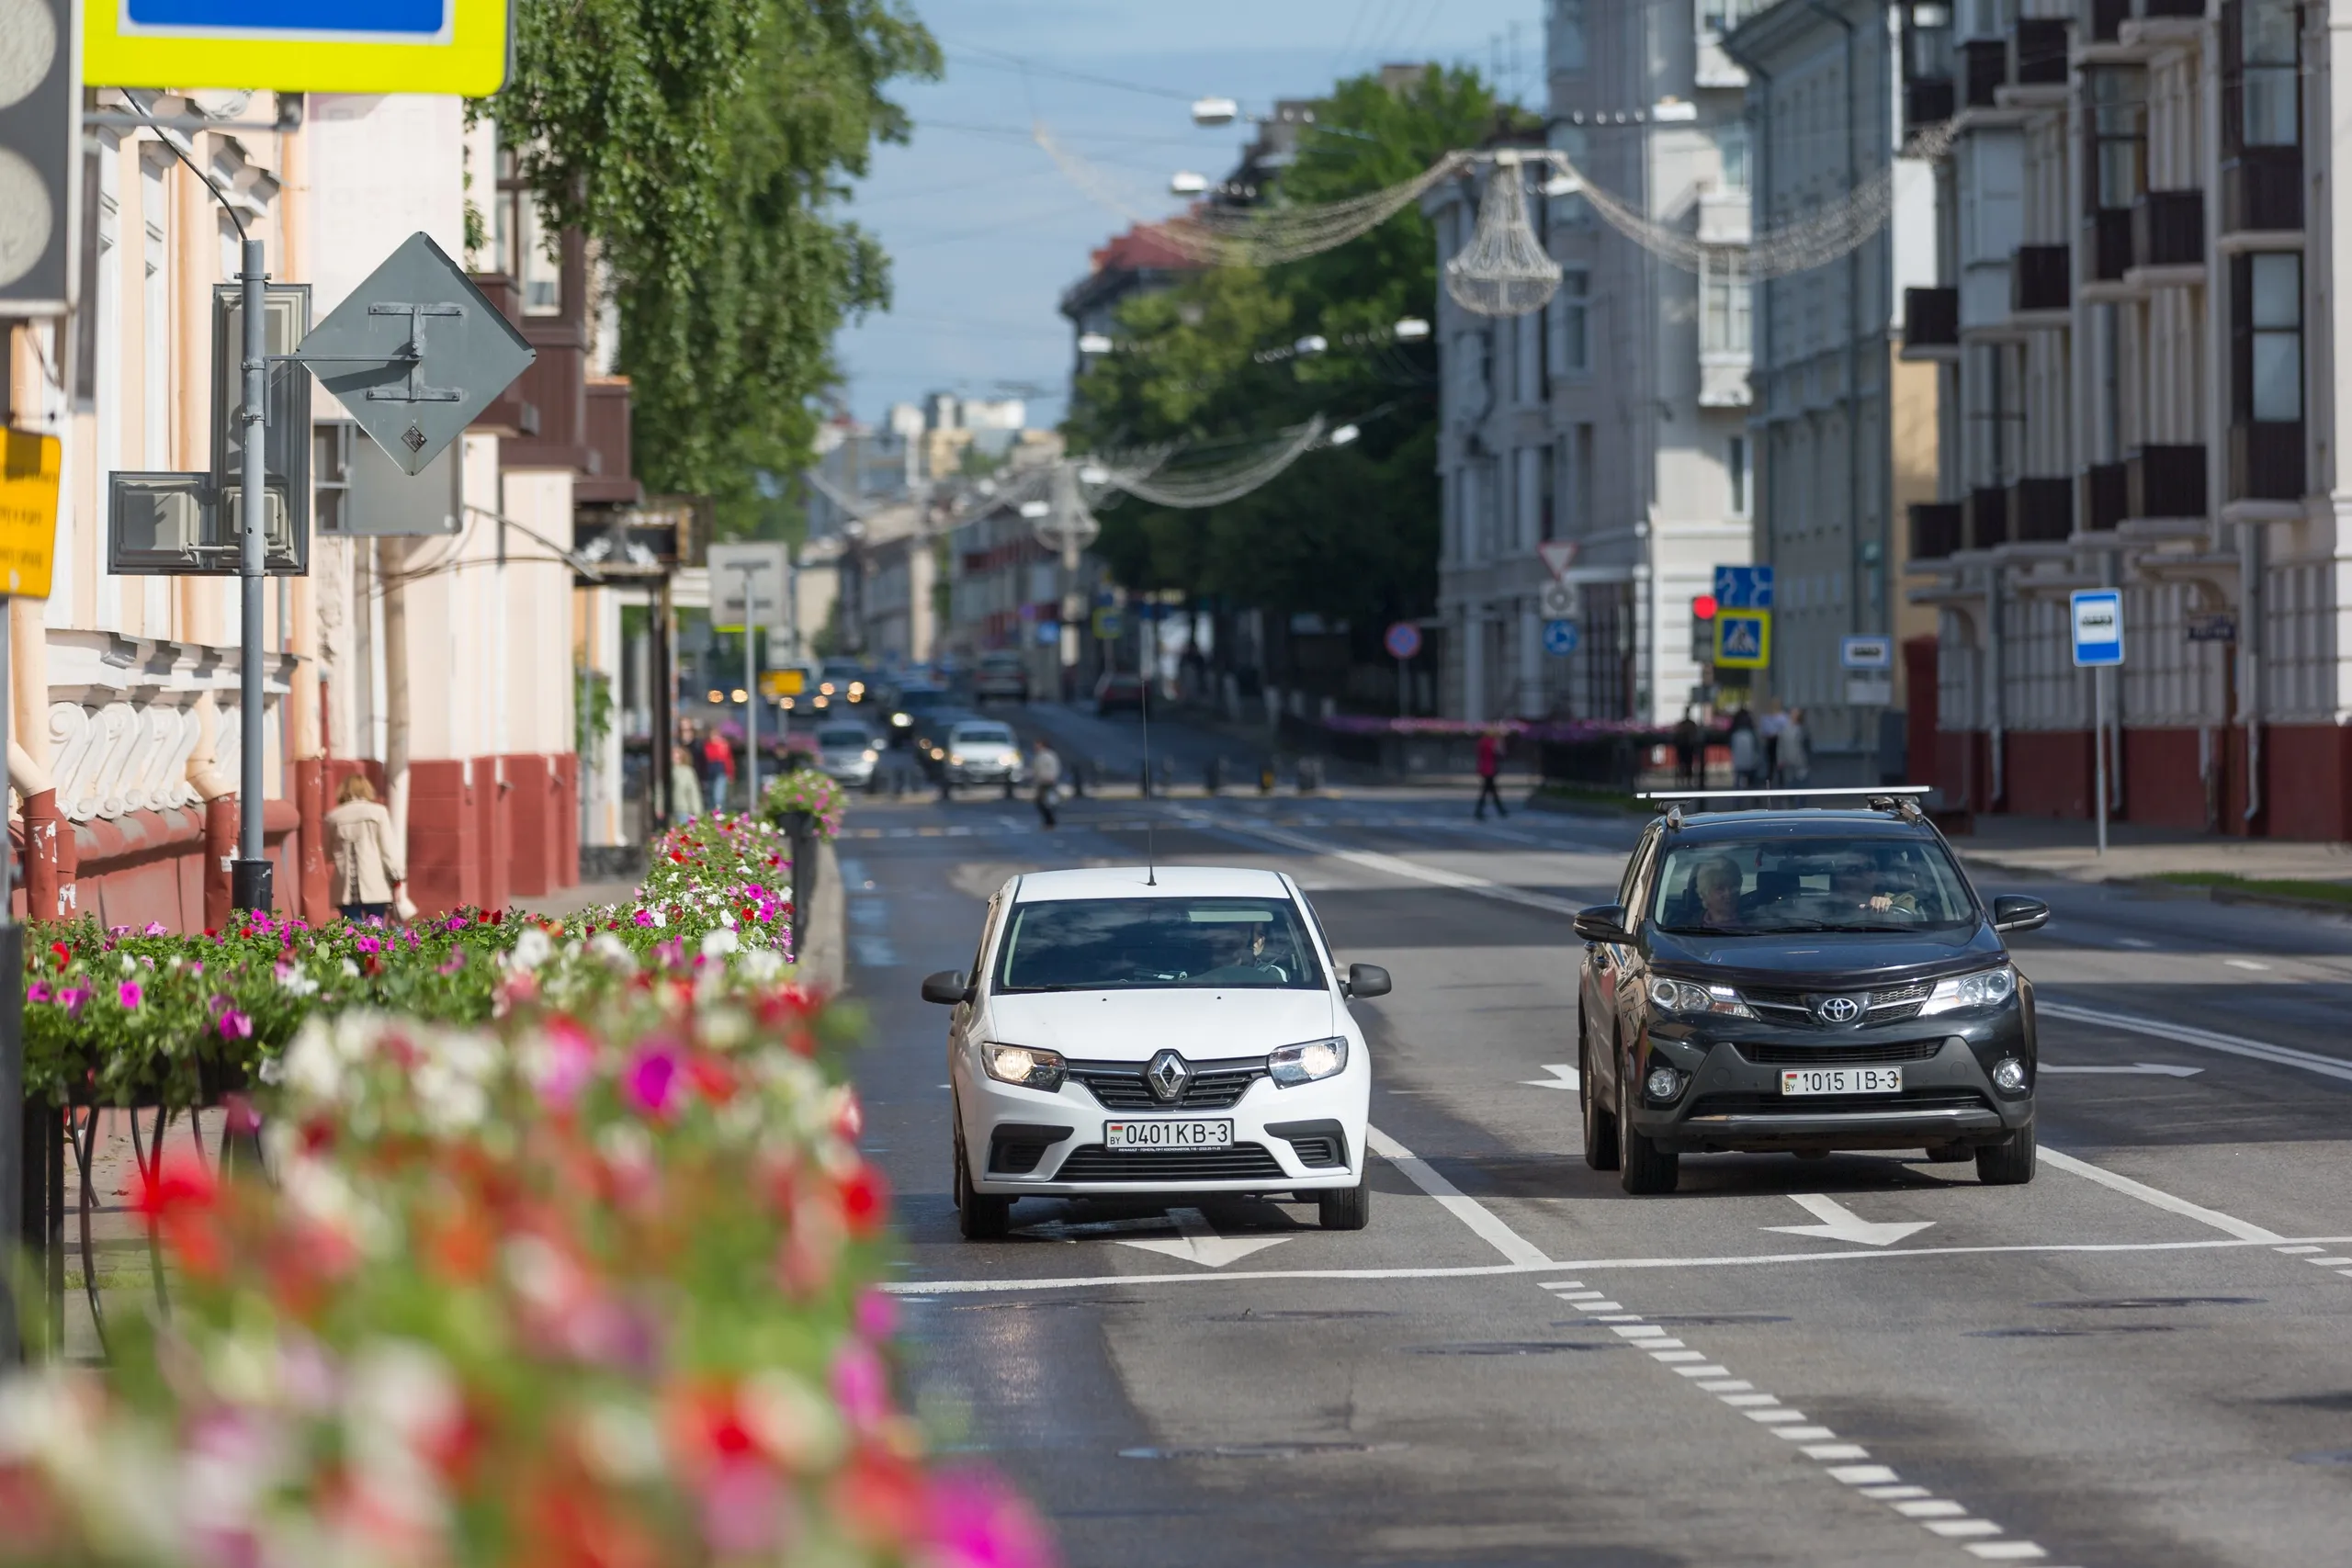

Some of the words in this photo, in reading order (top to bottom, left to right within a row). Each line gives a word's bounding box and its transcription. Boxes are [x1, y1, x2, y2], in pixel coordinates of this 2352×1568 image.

[1785, 1084, 1795, 1092] BY
[1803, 1072, 1845, 1091] 1015
[1856, 1070, 1897, 1090] IB-3
[1110, 1136, 1121, 1145] BY
